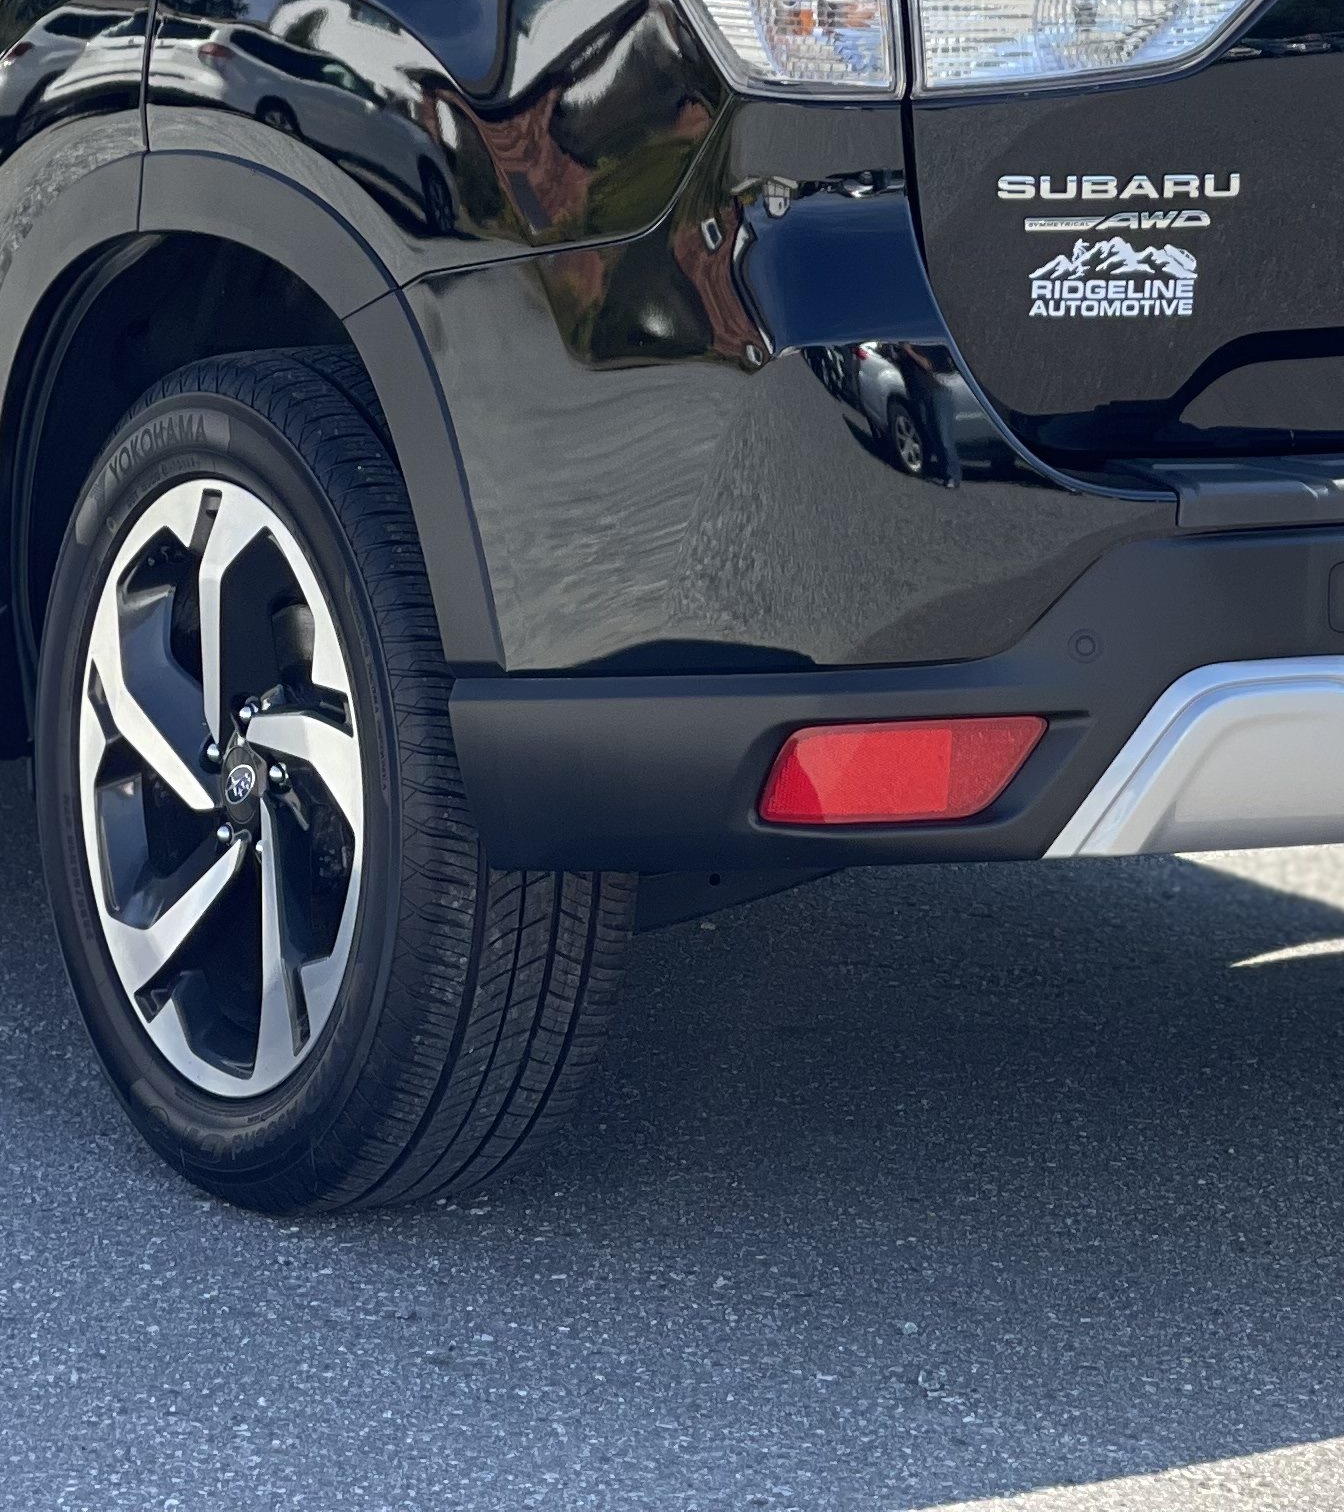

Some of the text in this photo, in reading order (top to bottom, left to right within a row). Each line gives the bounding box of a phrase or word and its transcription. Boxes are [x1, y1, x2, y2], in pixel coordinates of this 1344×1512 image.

[997, 173, 1240, 199] SUBARU
[1096, 209, 1211, 230] AWD
[1031, 279, 1194, 299] RIDGELINE
[1028, 299, 1193, 317] AUTOMOTIVE
[109, 414, 205, 480] YOKOHAMA
